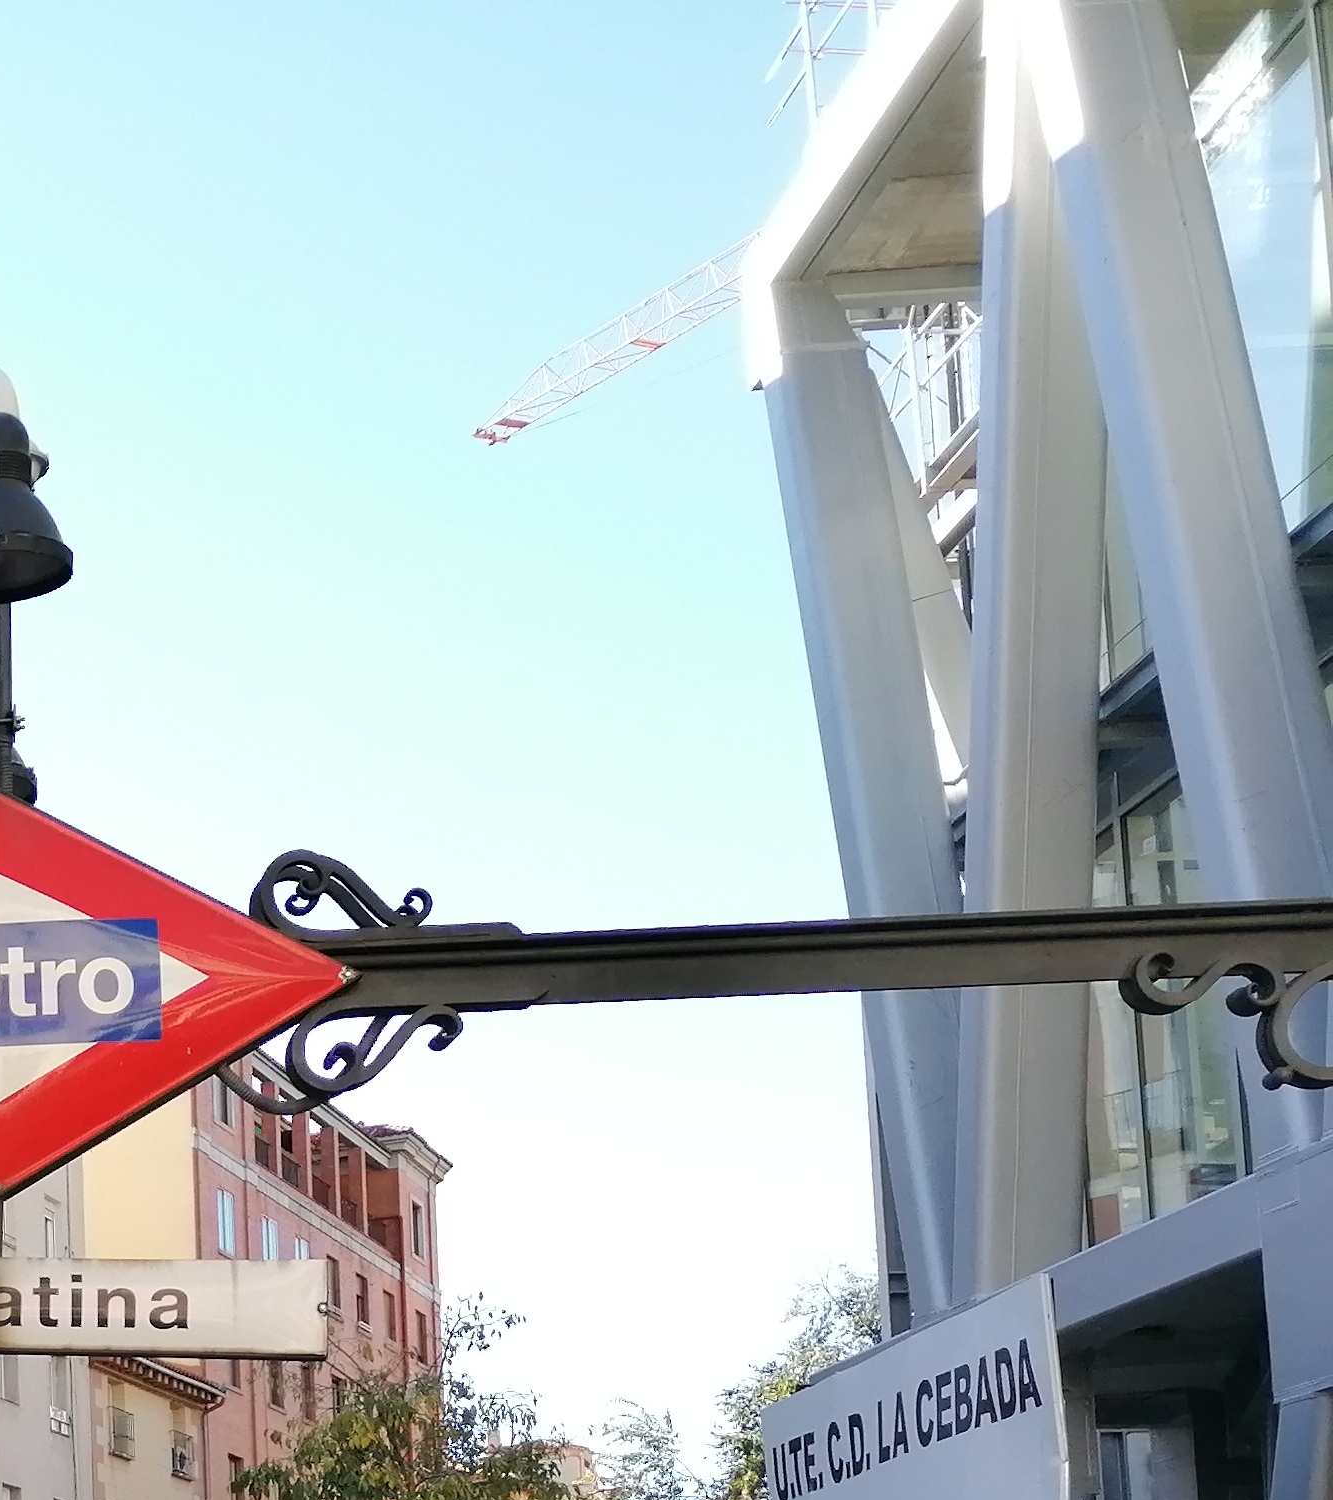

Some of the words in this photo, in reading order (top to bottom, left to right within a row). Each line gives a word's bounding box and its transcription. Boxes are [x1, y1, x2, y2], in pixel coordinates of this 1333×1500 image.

[826, 1412, 872, 1485] C.D.
[877, 1387, 910, 1464] LA
[915, 1337, 1043, 1448] CEBADA
